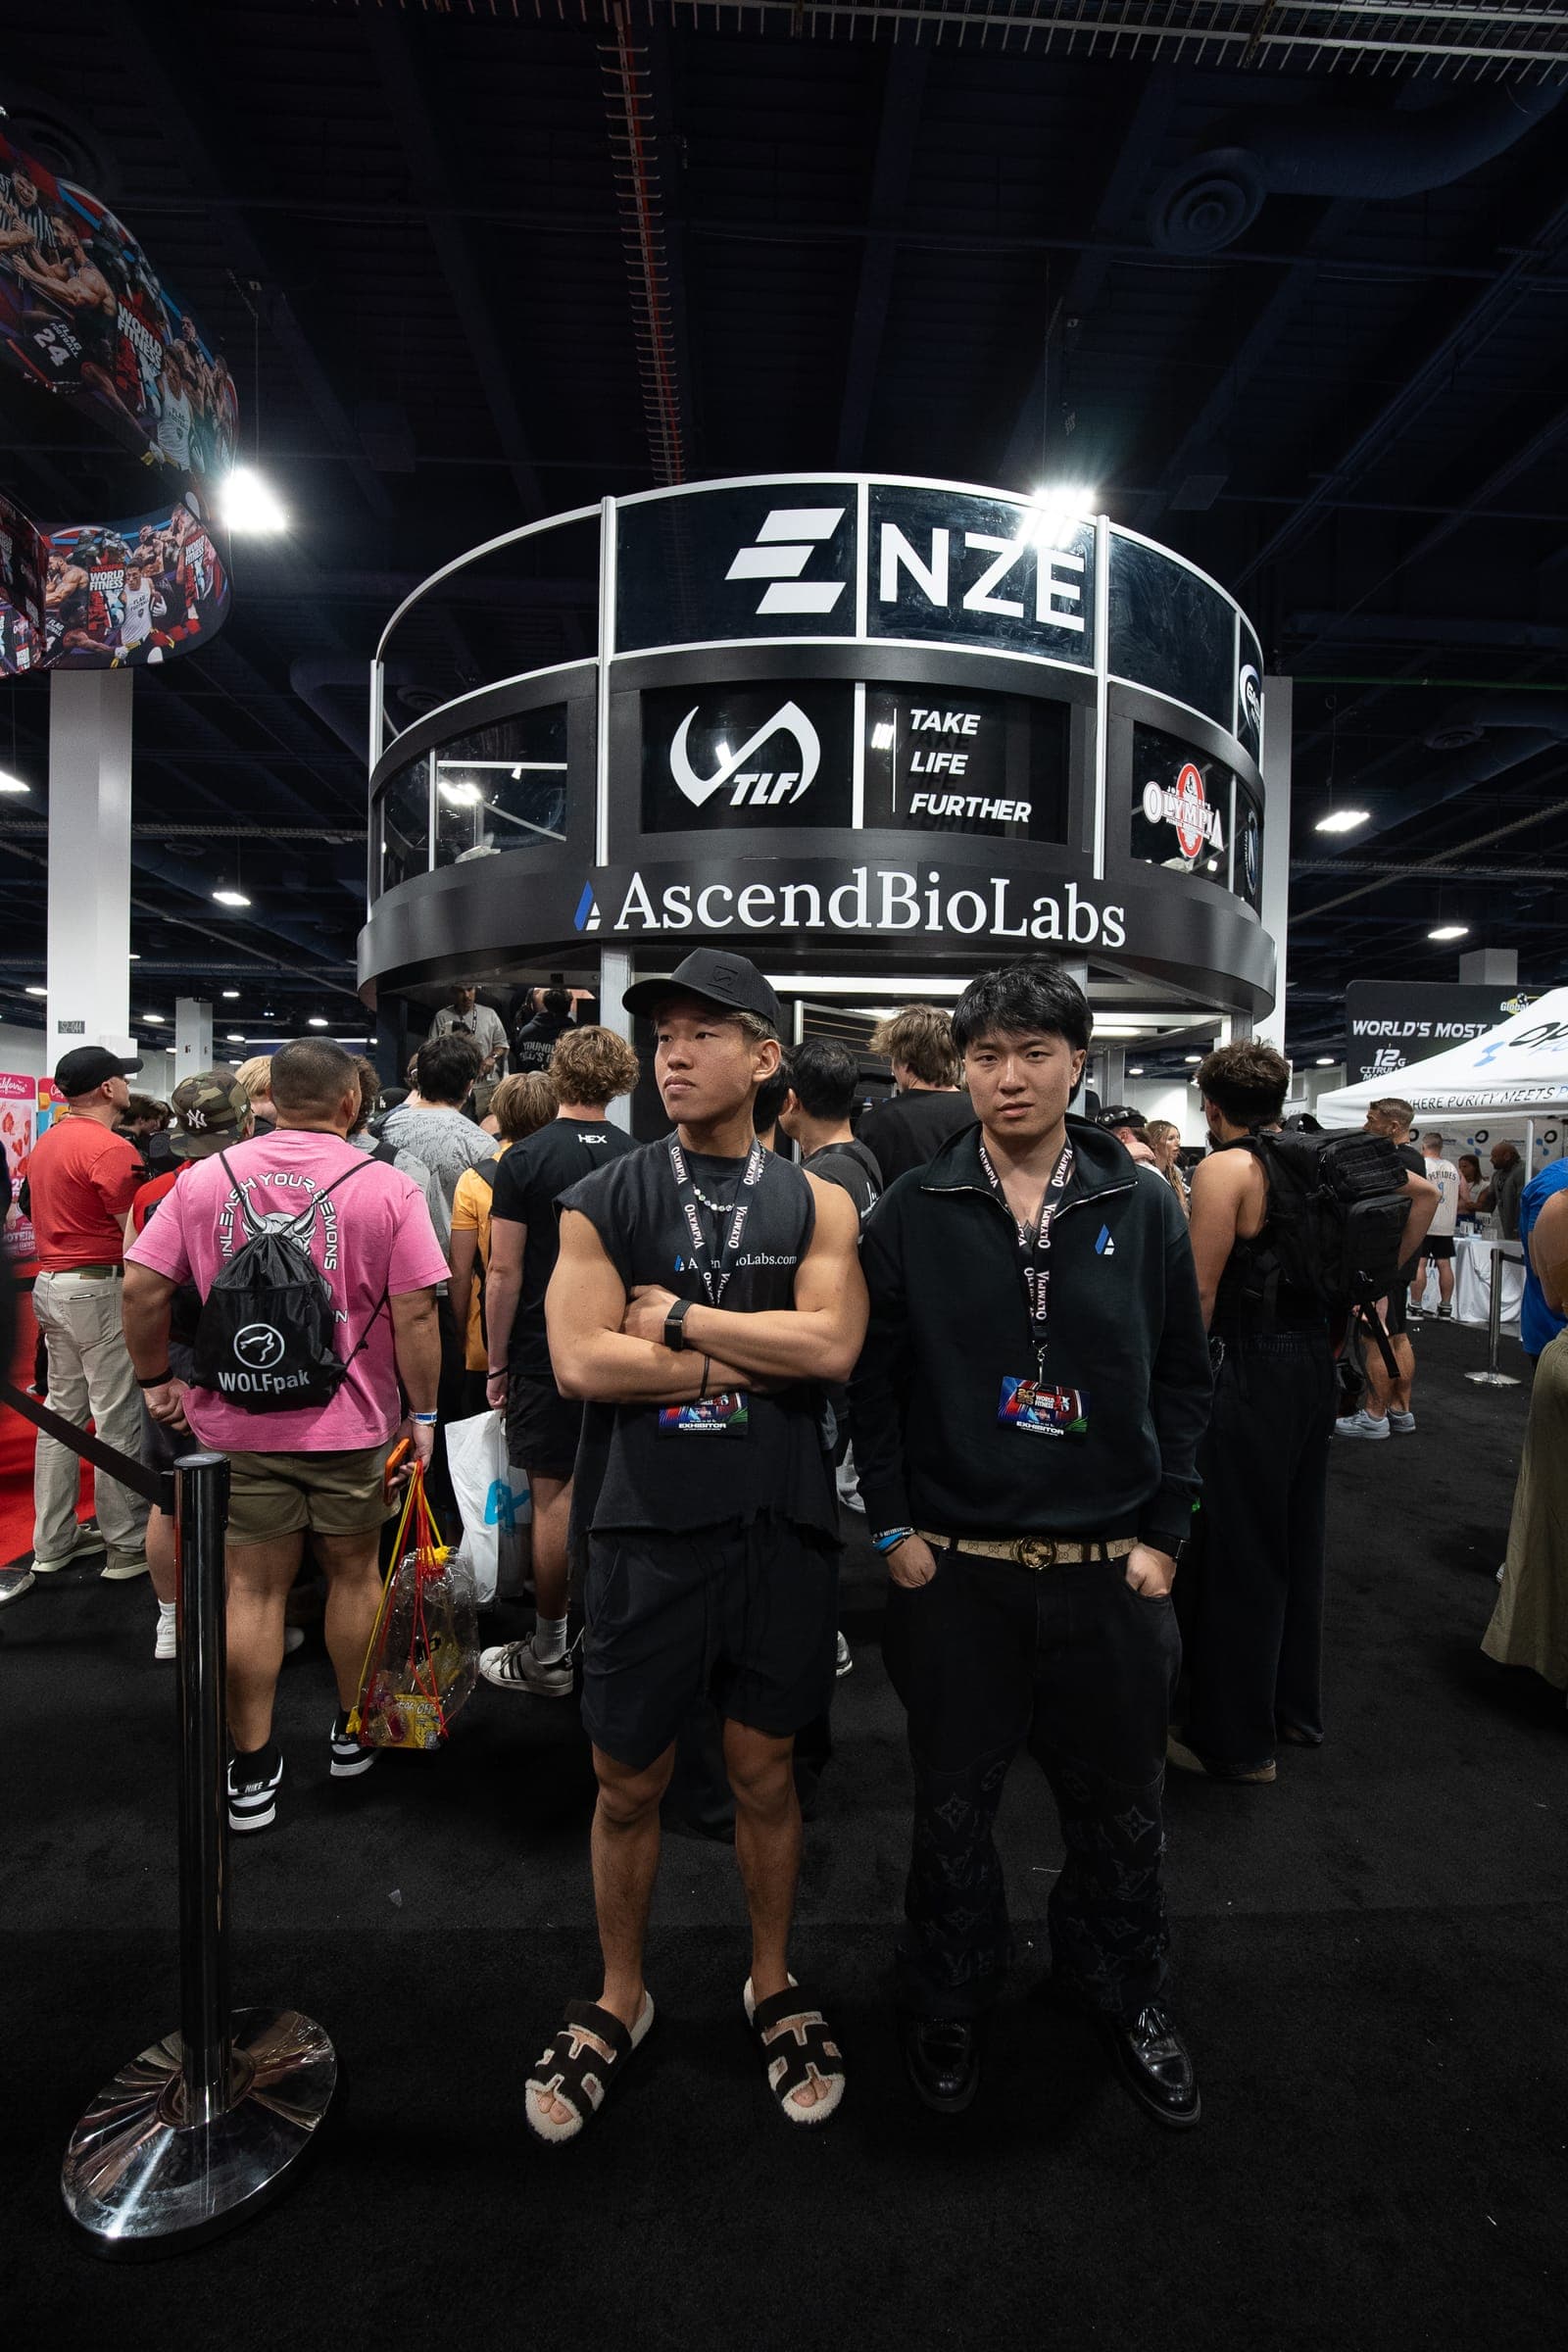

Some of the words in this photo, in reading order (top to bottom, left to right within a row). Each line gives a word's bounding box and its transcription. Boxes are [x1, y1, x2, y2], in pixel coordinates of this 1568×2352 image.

[59, 323, 82, 351] FLAG
[118, 302, 163, 357] WORLD
[118, 316, 161, 370] FITNESS
[33, 328, 71, 368] 24
[89, 579, 123, 591] FITNESS
[90, 570, 124, 582] WORLD
[910, 709, 981, 735] TAKE
[909, 752, 968, 775] LIFE
[729, 772, 800, 807] TLF
[909, 793, 1032, 822] FURTHER
[1143, 781, 1224, 852] OLYMPIA
[613, 866, 1126, 947] AscendBioLabs
[1351, 1020, 1431, 1038] WORLD'S
[1435, 1022, 1488, 1039] MOST
[1447, 1094, 1497, 1108] PURITY
[1502, 1087, 1555, 1103] MEETS
[186, 1109, 208, 1129] NY
[577, 1134, 608, 1144] HEX
[670, 1146, 688, 1185] OLYMPIA
[743, 1151, 760, 1186] OLYMPIA
[978, 1147, 999, 1188] OLYMPIA
[1052, 1148, 1073, 1188] OLYMPIA
[259, 1173, 316, 1193] YOUR
[684, 1204, 706, 1250] OLYMPIA
[728, 1205, 749, 1250] OLYMPIA
[1038, 1203, 1057, 1249] OLYMPIA
[1035, 1270, 1050, 1321] OLYMPIA
[218, 1370, 310, 1395] WOLFpak
[1016, 1421, 1064, 1435] EXHIBITOR
[245, 1781, 264, 1793] NIKE
